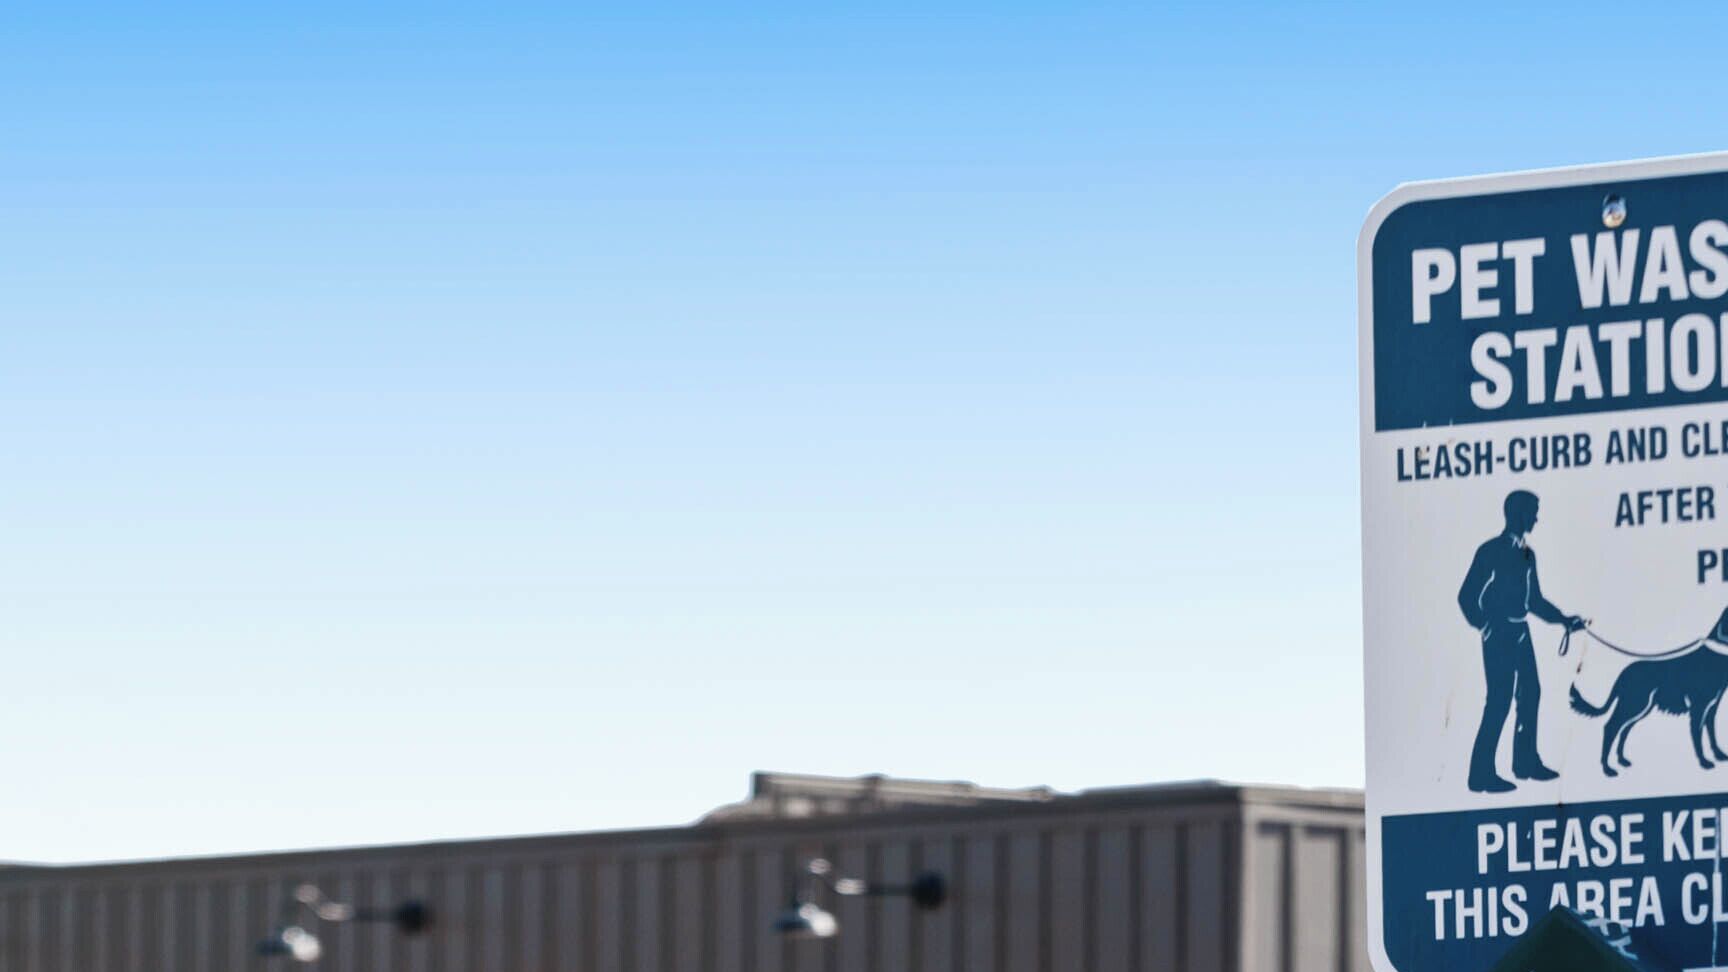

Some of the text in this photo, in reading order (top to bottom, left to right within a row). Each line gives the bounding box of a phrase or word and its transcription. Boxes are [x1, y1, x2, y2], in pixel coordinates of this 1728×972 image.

[1411, 237, 1546, 324] PET
[1396, 432, 1593, 483] LEASH-CURB
[1604, 425, 1668, 465] AND
[1614, 485, 1716, 528] AFTER
[1477, 813, 1645, 875] PLEASE
[1425, 884, 1529, 941] THIS
